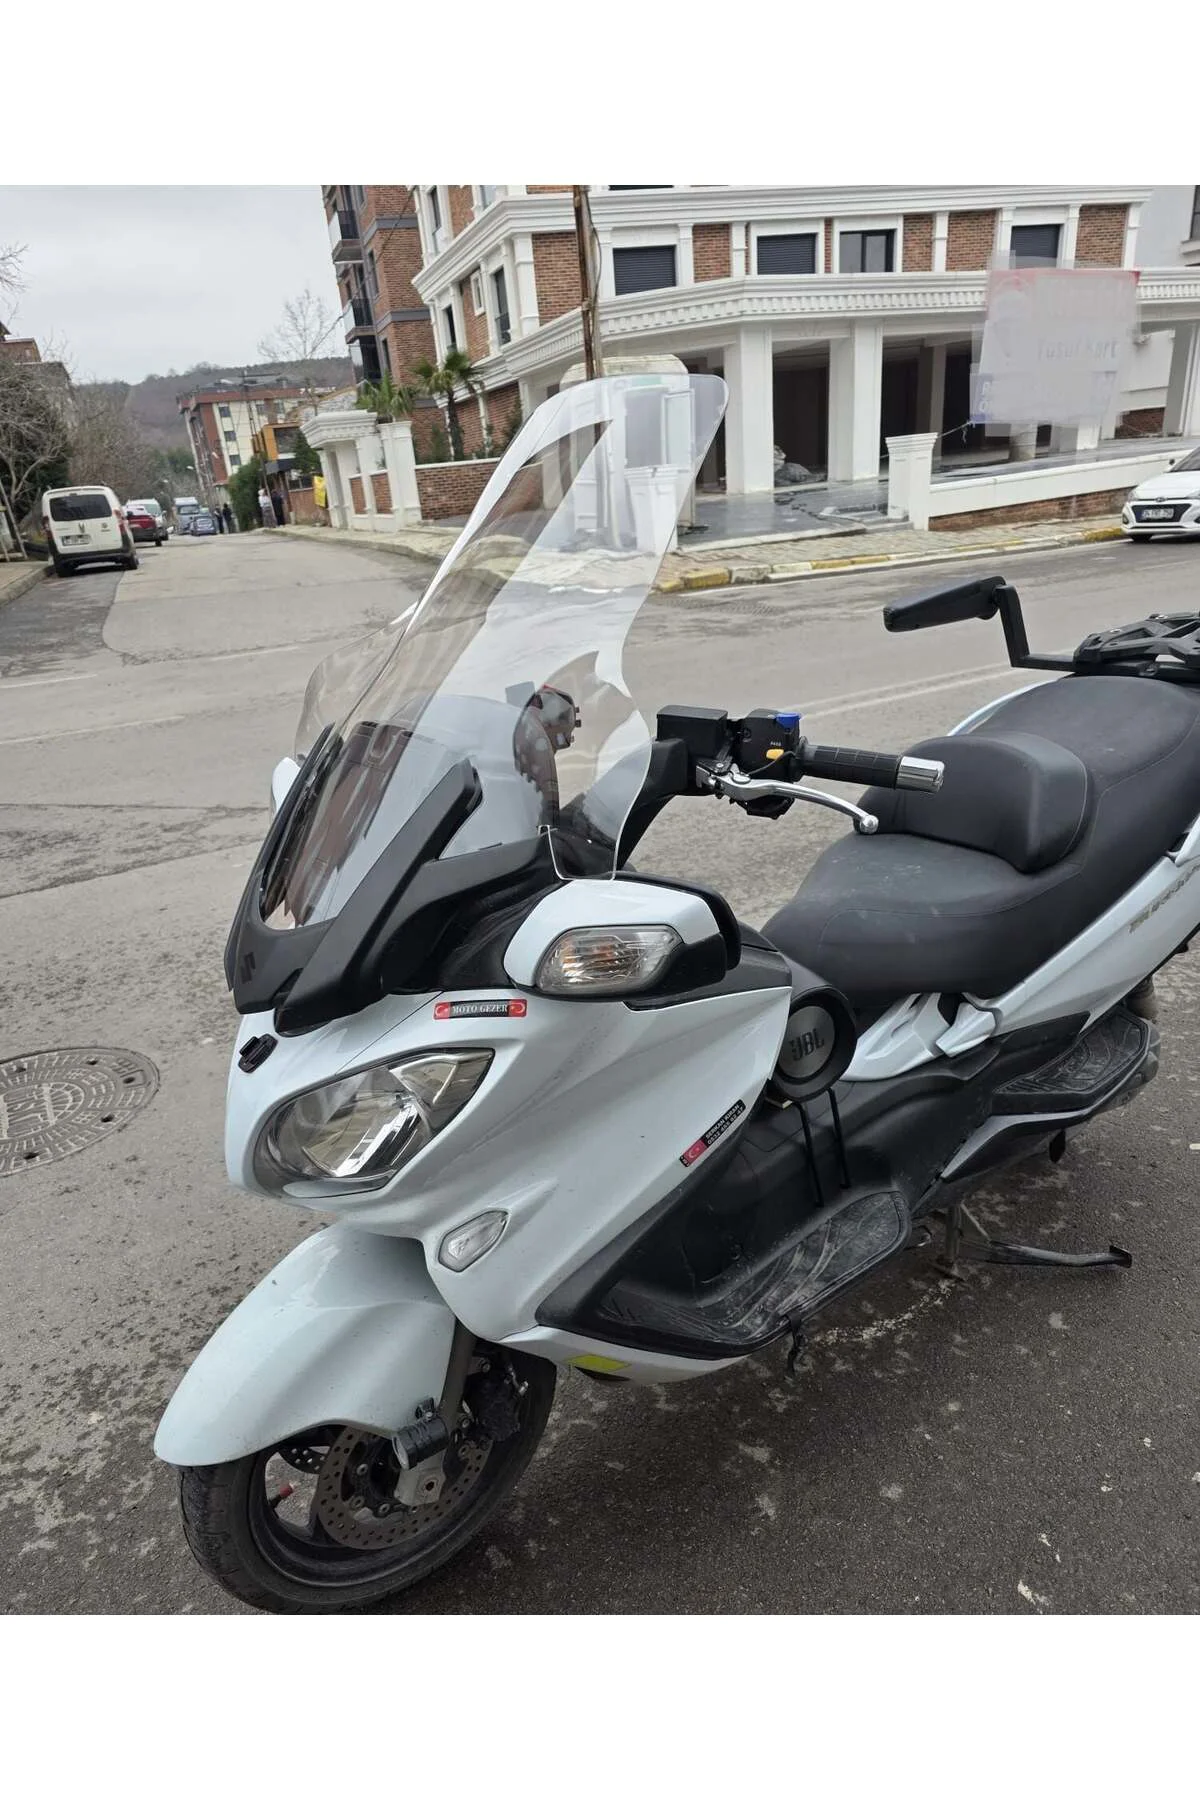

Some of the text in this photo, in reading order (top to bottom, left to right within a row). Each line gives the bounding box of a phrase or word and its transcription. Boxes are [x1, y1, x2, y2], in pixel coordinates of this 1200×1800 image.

[452, 1003, 507, 1014] MOTO GEZER
[788, 1028, 825, 1061] JBL
